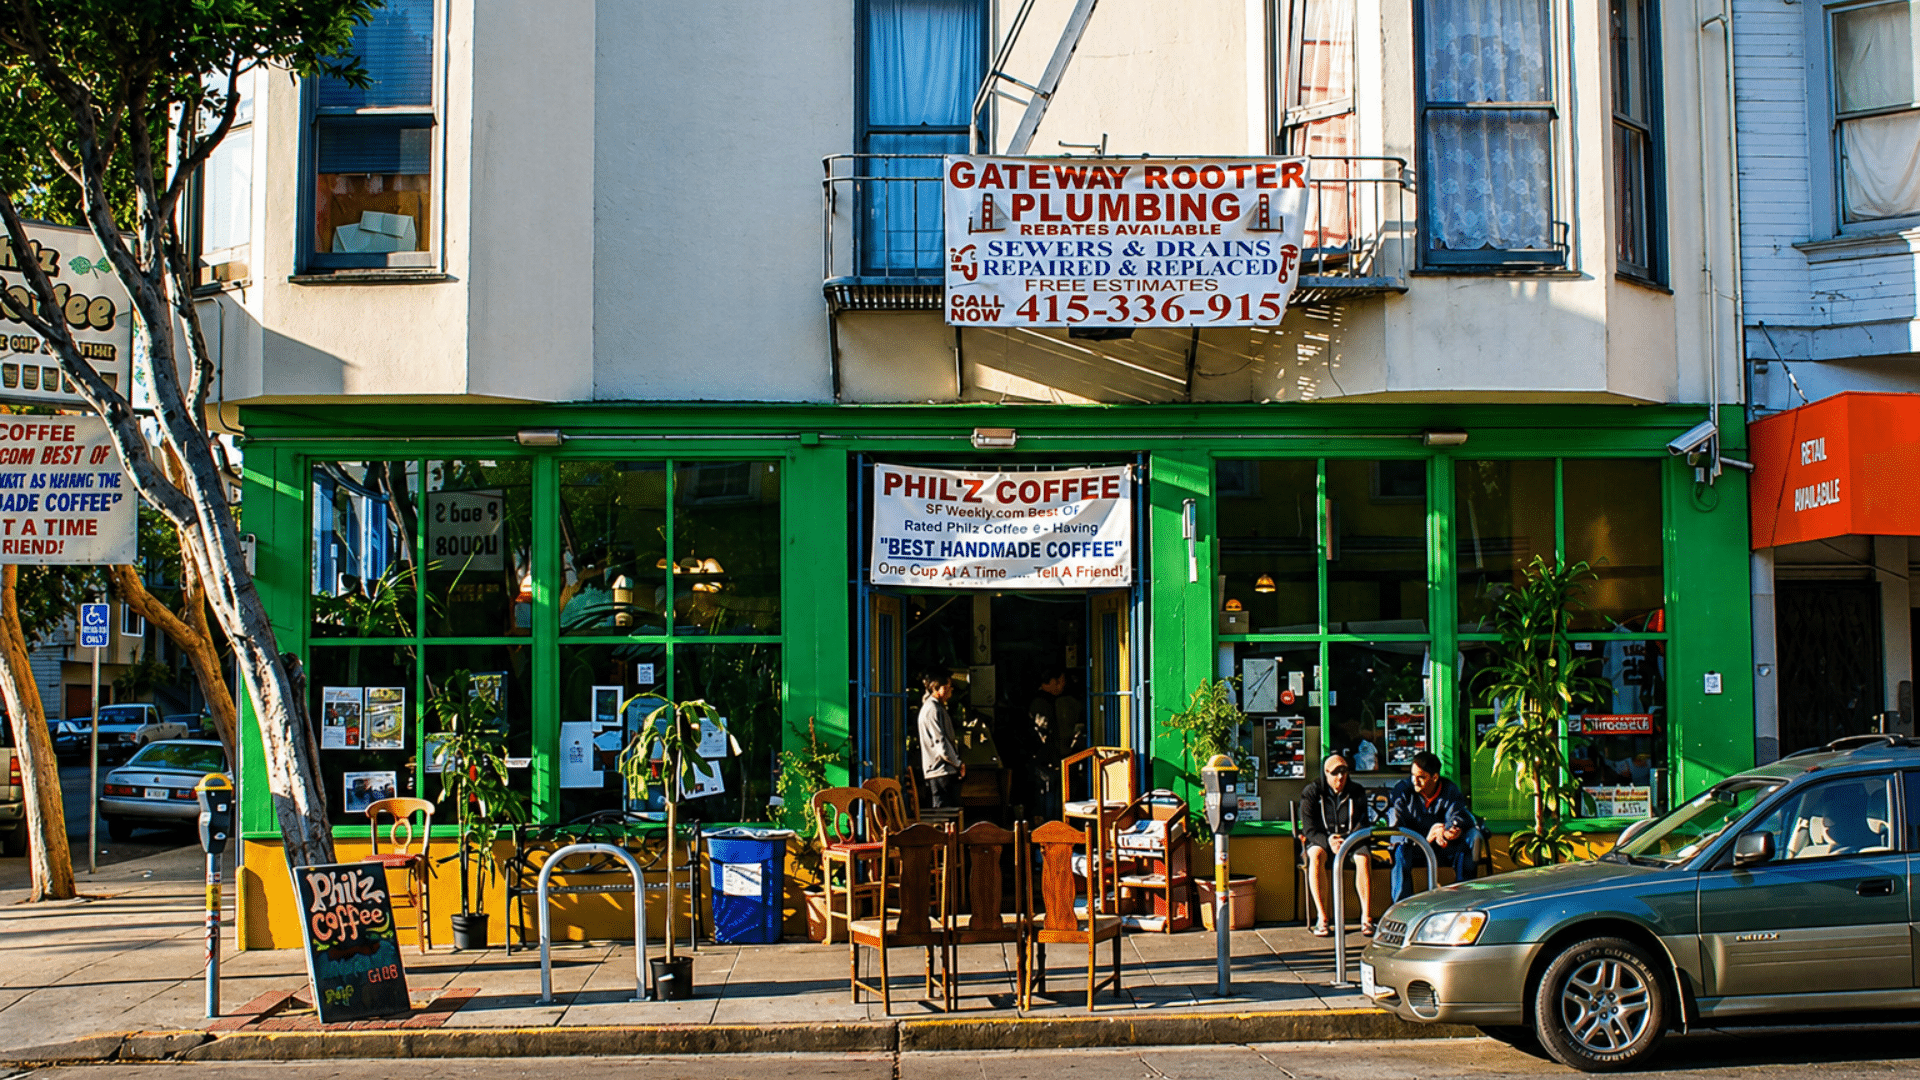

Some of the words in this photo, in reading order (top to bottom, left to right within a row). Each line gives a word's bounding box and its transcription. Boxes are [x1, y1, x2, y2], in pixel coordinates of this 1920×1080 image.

[949, 161, 1131, 190] GATEWAY
[1144, 161, 1306, 190] ROOTER
[1011, 193, 1241, 222] PLUMBING
[1020, 223, 1110, 236] REBATES
[1115, 223, 1222, 236] AVAILABLE
[988, 240, 1113, 258] SEWERS
[1122, 240, 1146, 258] &
[1156, 240, 1271, 257] DRAINS
[983, 259, 1111, 276] REPAIRED
[1118, 259, 1139, 276] &
[1146, 258, 1278, 277] REPLACED
[1025, 279, 1087, 292] FREE
[1092, 278, 1219, 292] ESTIMATES
[951, 294, 1005, 309] CALL
[1016, 292, 1282, 323] 415-336-915
[951, 308, 1001, 322] NOW
[0, 423, 76, 442] COFFEE
[40, 445, 86, 465] BEST
[89, 445, 112, 465] OF
[1800, 437, 1828, 467] RETAIL
[29, 472, 47, 489] AS
[883, 472, 984, 503] PHIL'Z
[996, 474, 1121, 504] COFFEE
[925, 504, 943, 516] SF
[945, 505, 1025, 521] Weekly.com
[1028, 507, 1059, 518] Best
[1062, 505, 1080, 516] Of
[21, 519, 37, 536] A
[44, 519, 98, 536] TIME
[904, 519, 942, 533] Rated
[946, 521, 980, 535] Philz
[984, 523, 1028, 535] Coffee
[1052, 523, 1099, 536] Having
[2, 539, 65, 555] RIEND!
[880, 536, 935, 557] "BEST
[940, 539, 1041, 558] HANDMADE
[1046, 540, 1123, 558] COFFEE"
[878, 561, 906, 576] One
[910, 564, 939, 580] Cup
[942, 564, 958, 578] At
[959, 565, 971, 578] A
[973, 565, 1007, 579] Time
[1033, 566, 1059, 578] Tell
[1061, 565, 1072, 578] A
[1076, 564, 1124, 578] Friend!
[311, 904, 385, 942] Coffee
